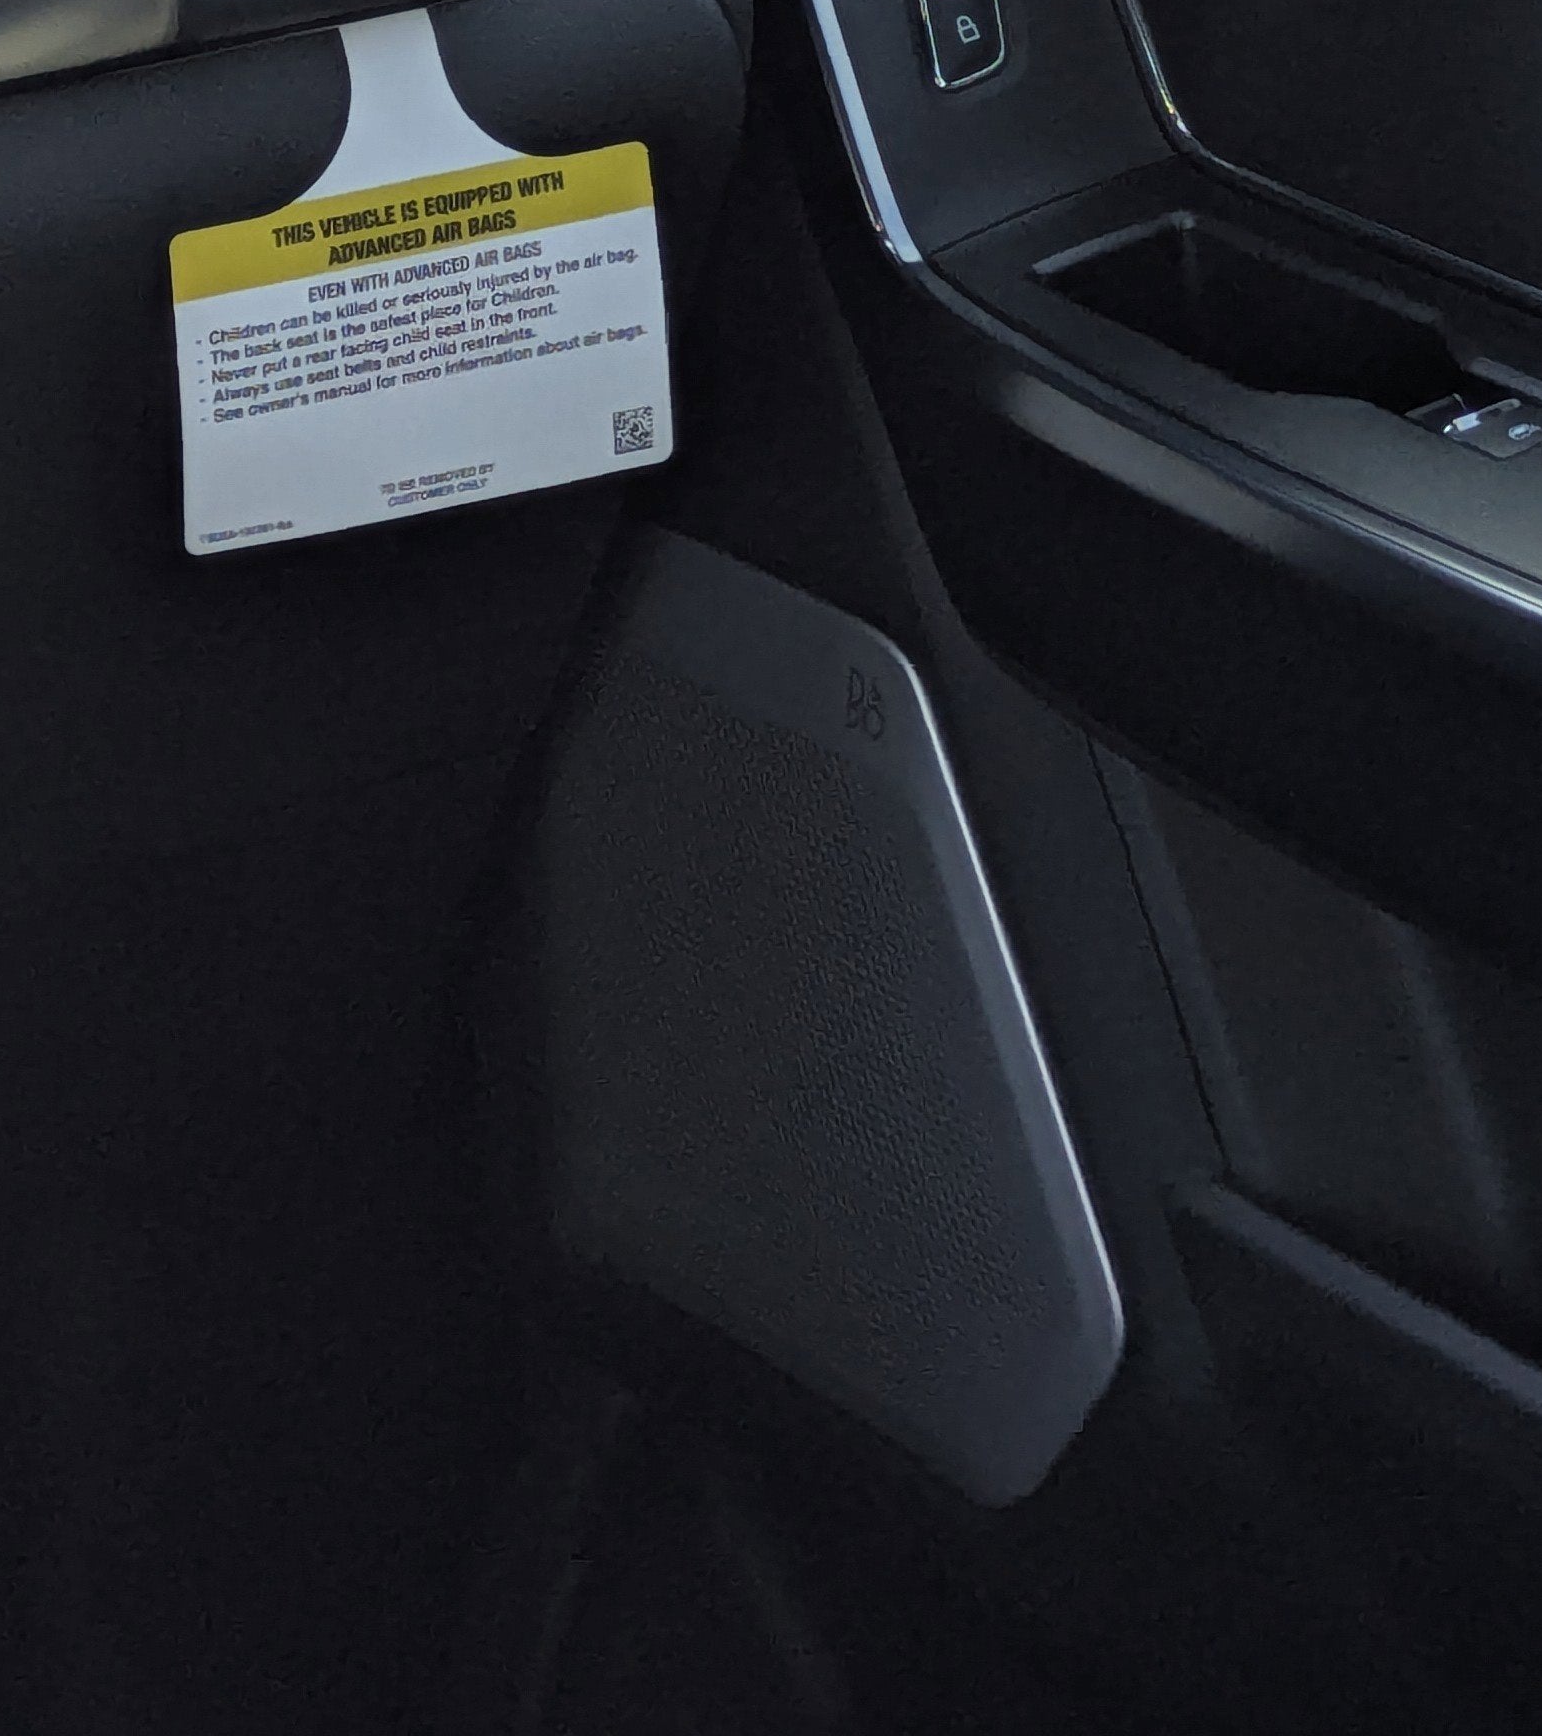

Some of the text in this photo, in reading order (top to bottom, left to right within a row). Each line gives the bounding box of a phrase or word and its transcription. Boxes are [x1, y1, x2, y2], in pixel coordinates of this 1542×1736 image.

[272, 170, 563, 248] THIS VEHICLE IS EQUIPPED WITH
[329, 208, 516, 265] ADVANCED AIR BAGS
[209, 244, 638, 345] Children can be killed or seriously injured by the air bag.
[309, 240, 541, 302] EVEN WITH ADVANCED AIR BAGS
[210, 280, 558, 365] The back seat is the safest place for Children.
[211, 301, 556, 384] Never put a rear facing child seat in the front.
[214, 323, 536, 406] Always use seat belts and child restraints.
[214, 321, 647, 423] See owner's manual for more information about air bags.
